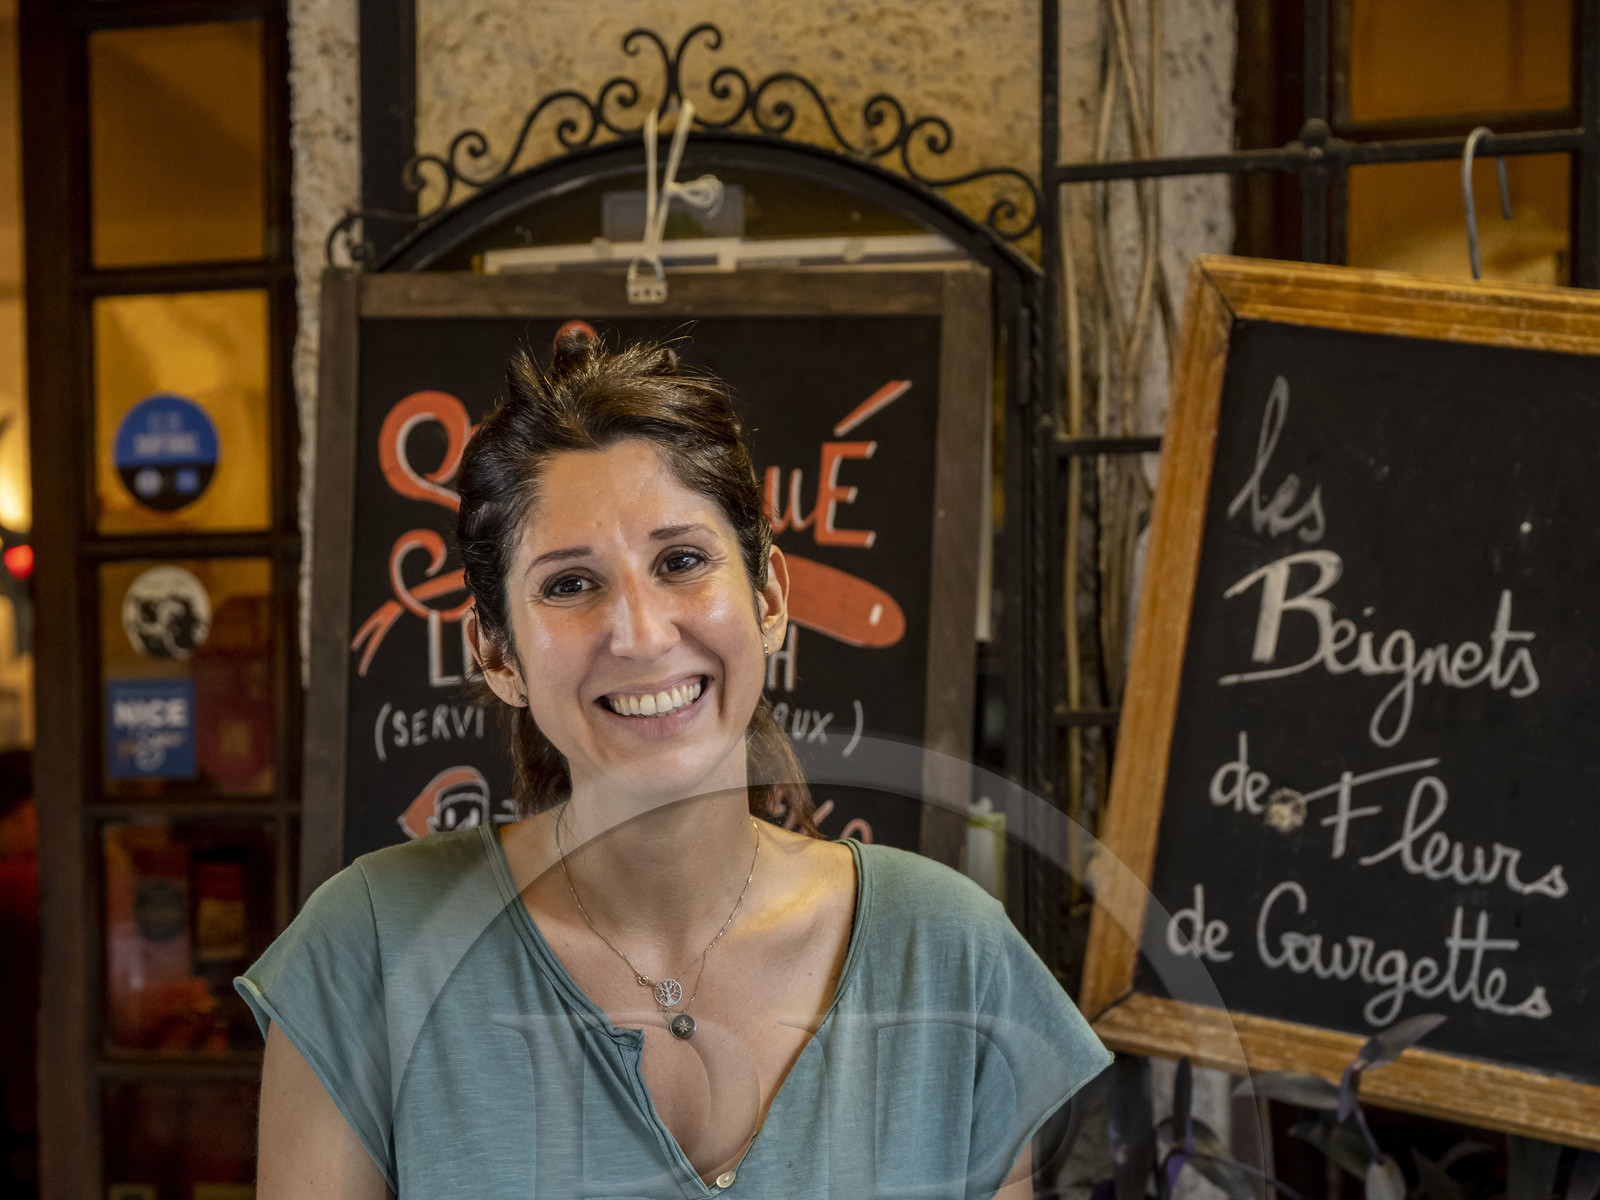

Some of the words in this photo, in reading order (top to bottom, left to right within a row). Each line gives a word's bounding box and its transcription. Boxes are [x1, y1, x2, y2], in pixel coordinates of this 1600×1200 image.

[1218, 549, 1540, 748] Beignets
[1209, 730, 1271, 815] de
[1302, 756, 1569, 899] Fleurs
[1166, 883, 1234, 962] de
[1256, 880, 1553, 1028] Courgettes
